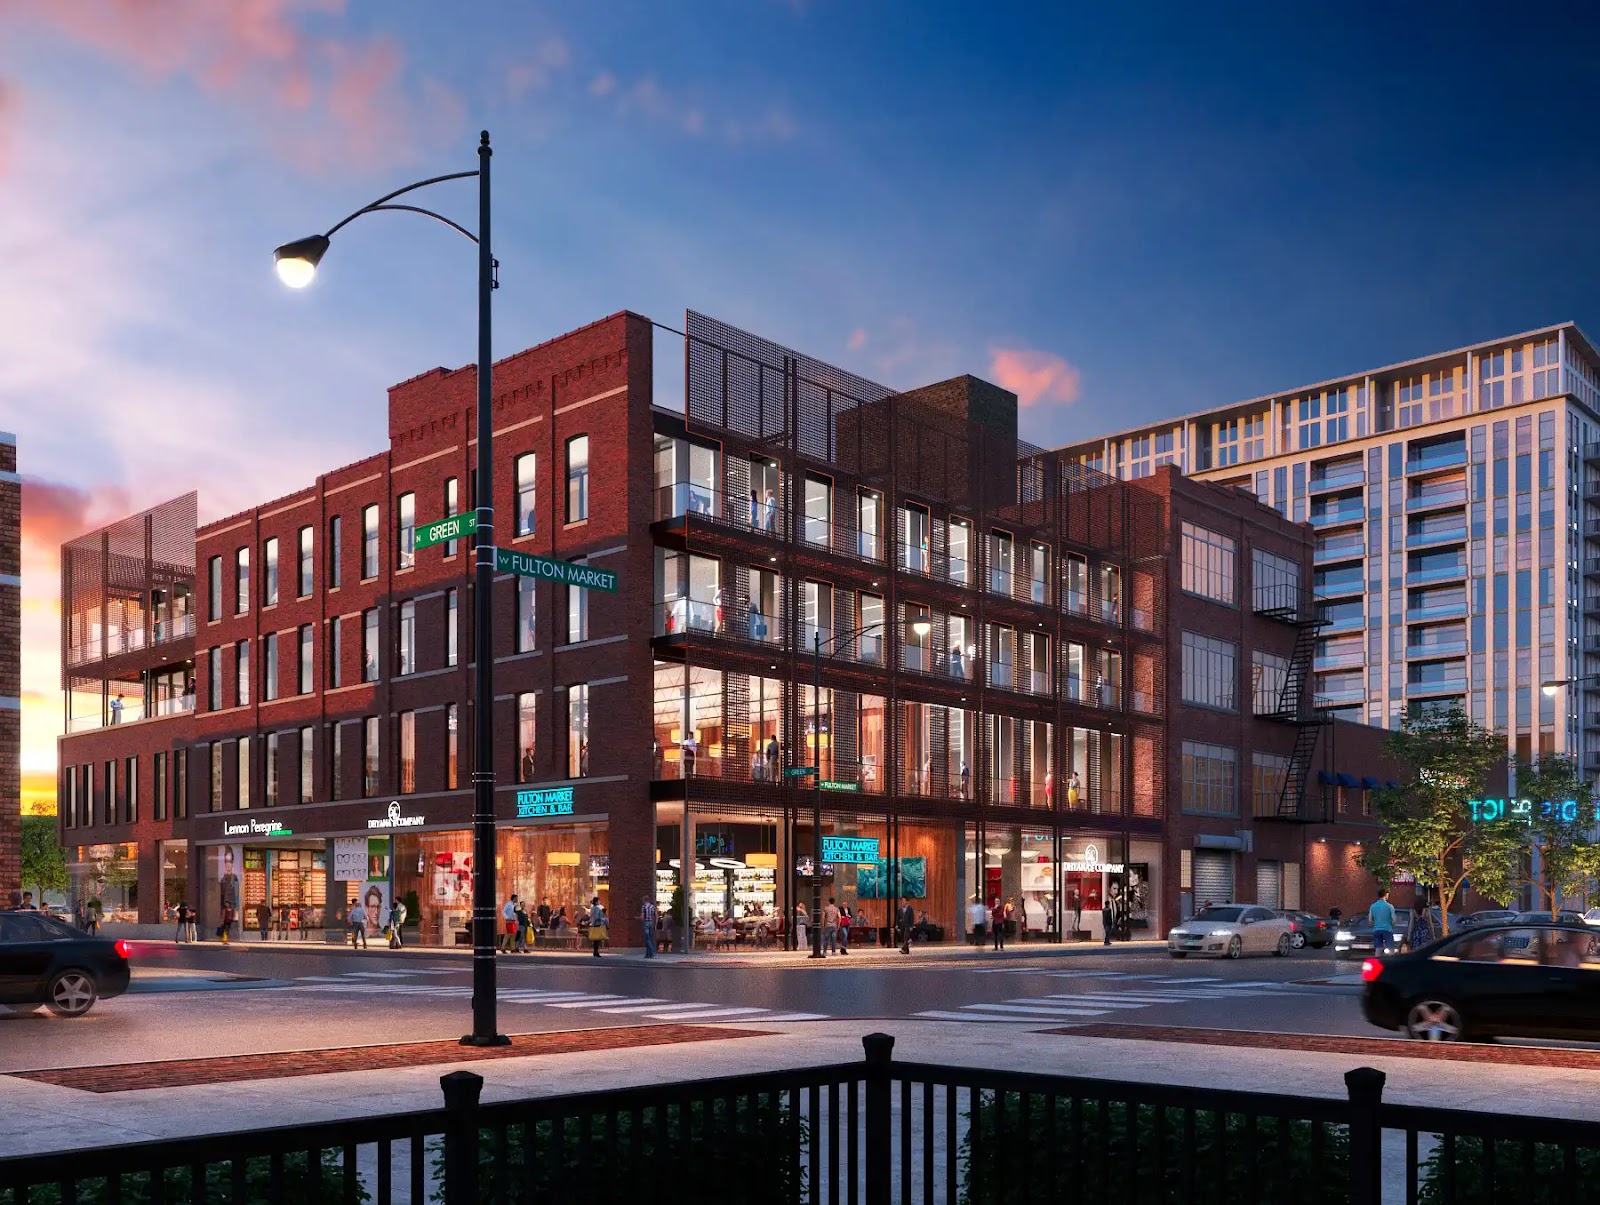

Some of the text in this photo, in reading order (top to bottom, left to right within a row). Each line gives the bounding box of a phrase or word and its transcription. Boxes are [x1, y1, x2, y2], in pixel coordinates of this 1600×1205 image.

[416, 518, 475, 543] N GREEN ST
[499, 555, 615, 589] W FULTON MARKET
[518, 791, 573, 804] FULTON MARKET
[519, 806, 547, 815] KITCHEN
[558, 804, 572, 812] BAR
[251, 818, 282, 836] Peregrine
[823, 840, 878, 852] FULTON MARKET
[824, 852, 854, 860] KITCHEN
[864, 853, 878, 861] BAR
